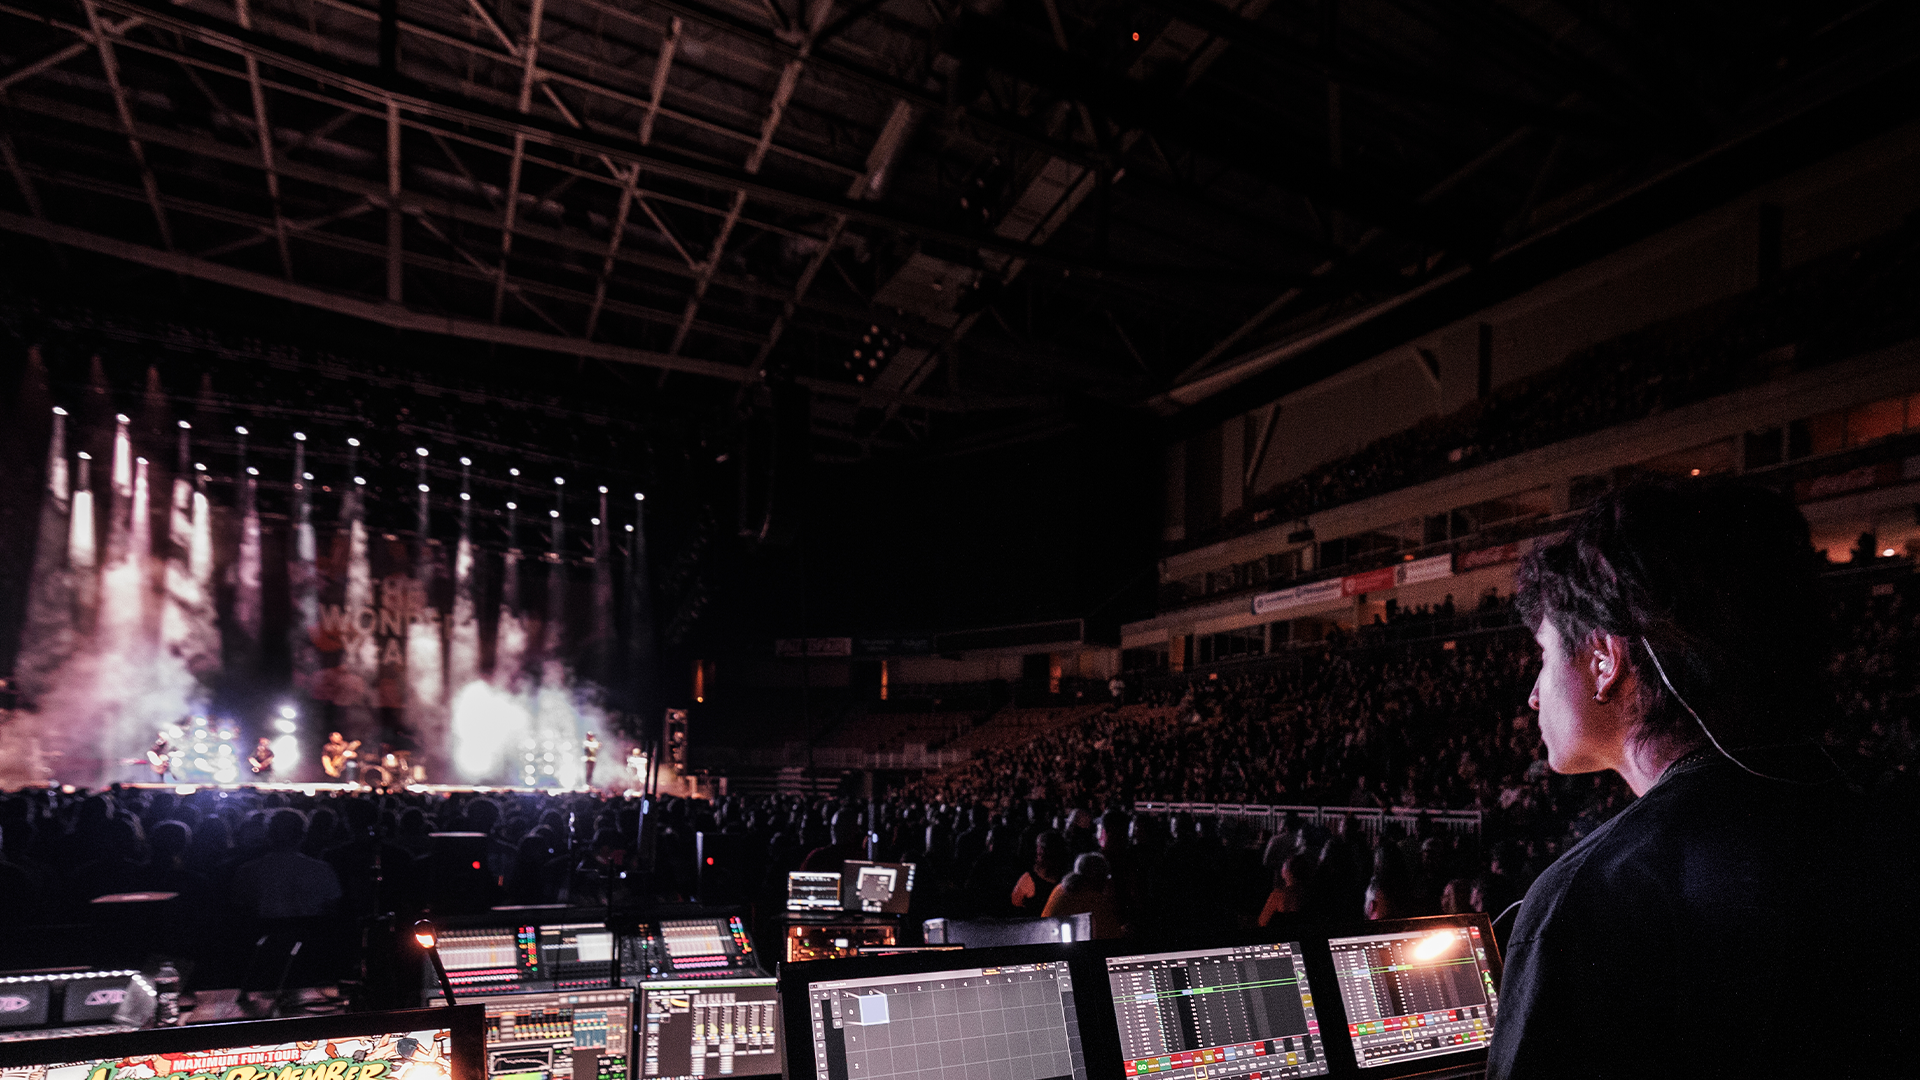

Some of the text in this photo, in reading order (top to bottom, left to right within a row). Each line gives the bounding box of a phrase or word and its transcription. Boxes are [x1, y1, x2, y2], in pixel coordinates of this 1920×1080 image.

[173, 1049, 300, 1071] MAXIMUM FUN TOUR
